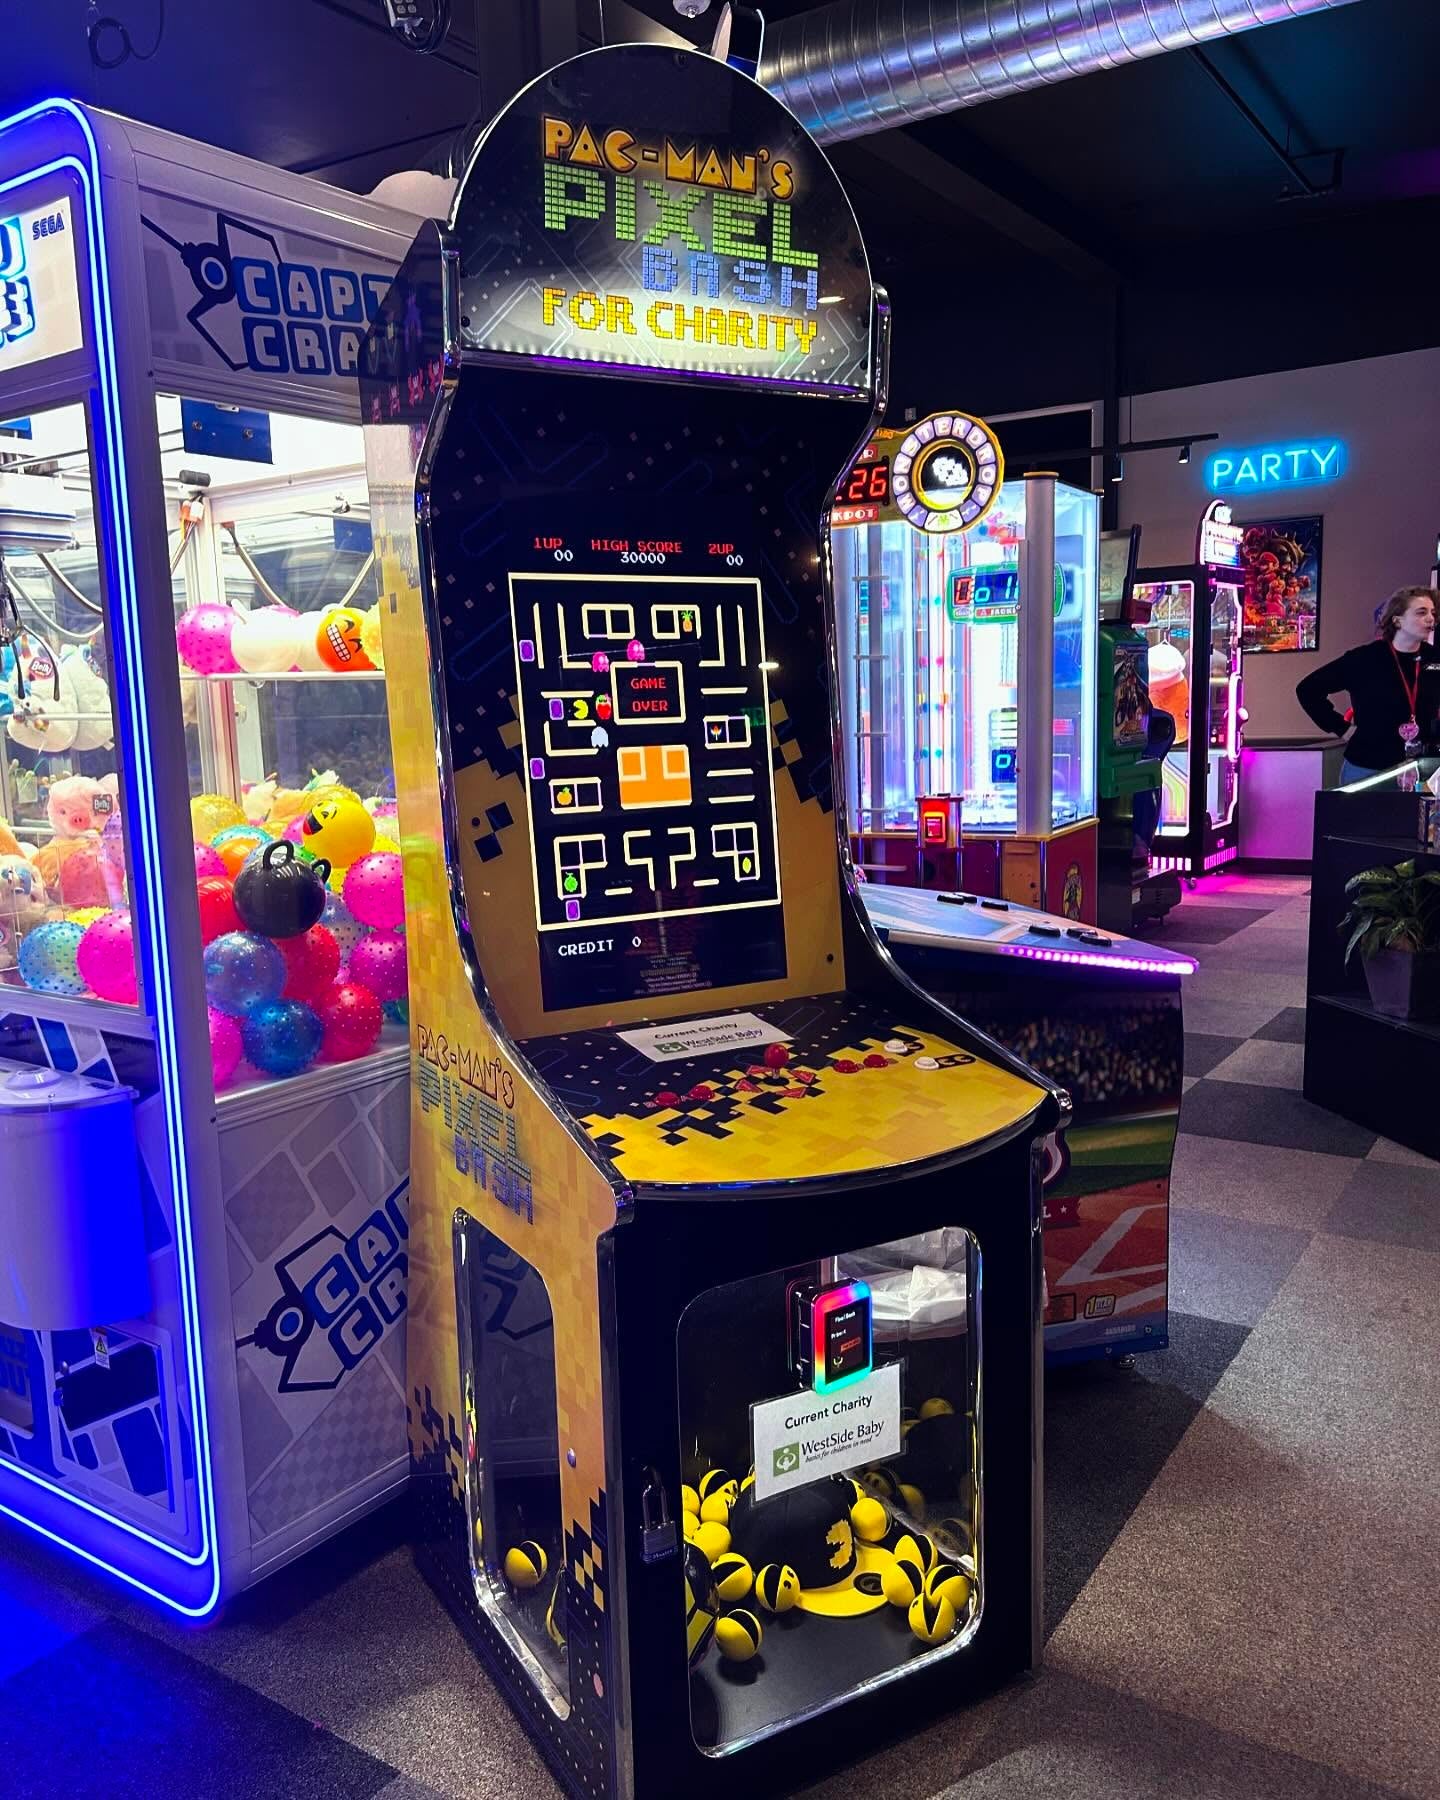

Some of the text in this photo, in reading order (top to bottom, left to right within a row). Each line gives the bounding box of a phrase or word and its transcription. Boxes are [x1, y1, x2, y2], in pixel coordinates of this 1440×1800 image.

[542, 115, 795, 200] PAC-MAN'S
[32, 212, 65, 240] SEGA
[543, 163, 818, 268] PIXEL
[642, 246, 818, 310] BASH
[542, 287, 817, 354] FOR CHARITY
[1213, 445, 1337, 488] PARTY
[534, 537, 734, 555] 1UP HIGH SCORE 2UP
[554, 550, 744, 566] 00 30000 00
[630, 678, 667, 689] GAME
[632, 700, 668, 712] OVER
[558, 936, 642, 957] CREDIT 0
[654, 1022, 738, 1040] Current Charity
[735, 1028, 764, 1038] Baby
[417, 1024, 515, 1109] PAC-MAN'S
[419, 1062, 532, 1183] PIXEL
[454, 1135, 534, 1225] BASH
[784, 1395, 873, 1430] Current Charity
[801, 1420, 885, 1456] WestSide Baby
